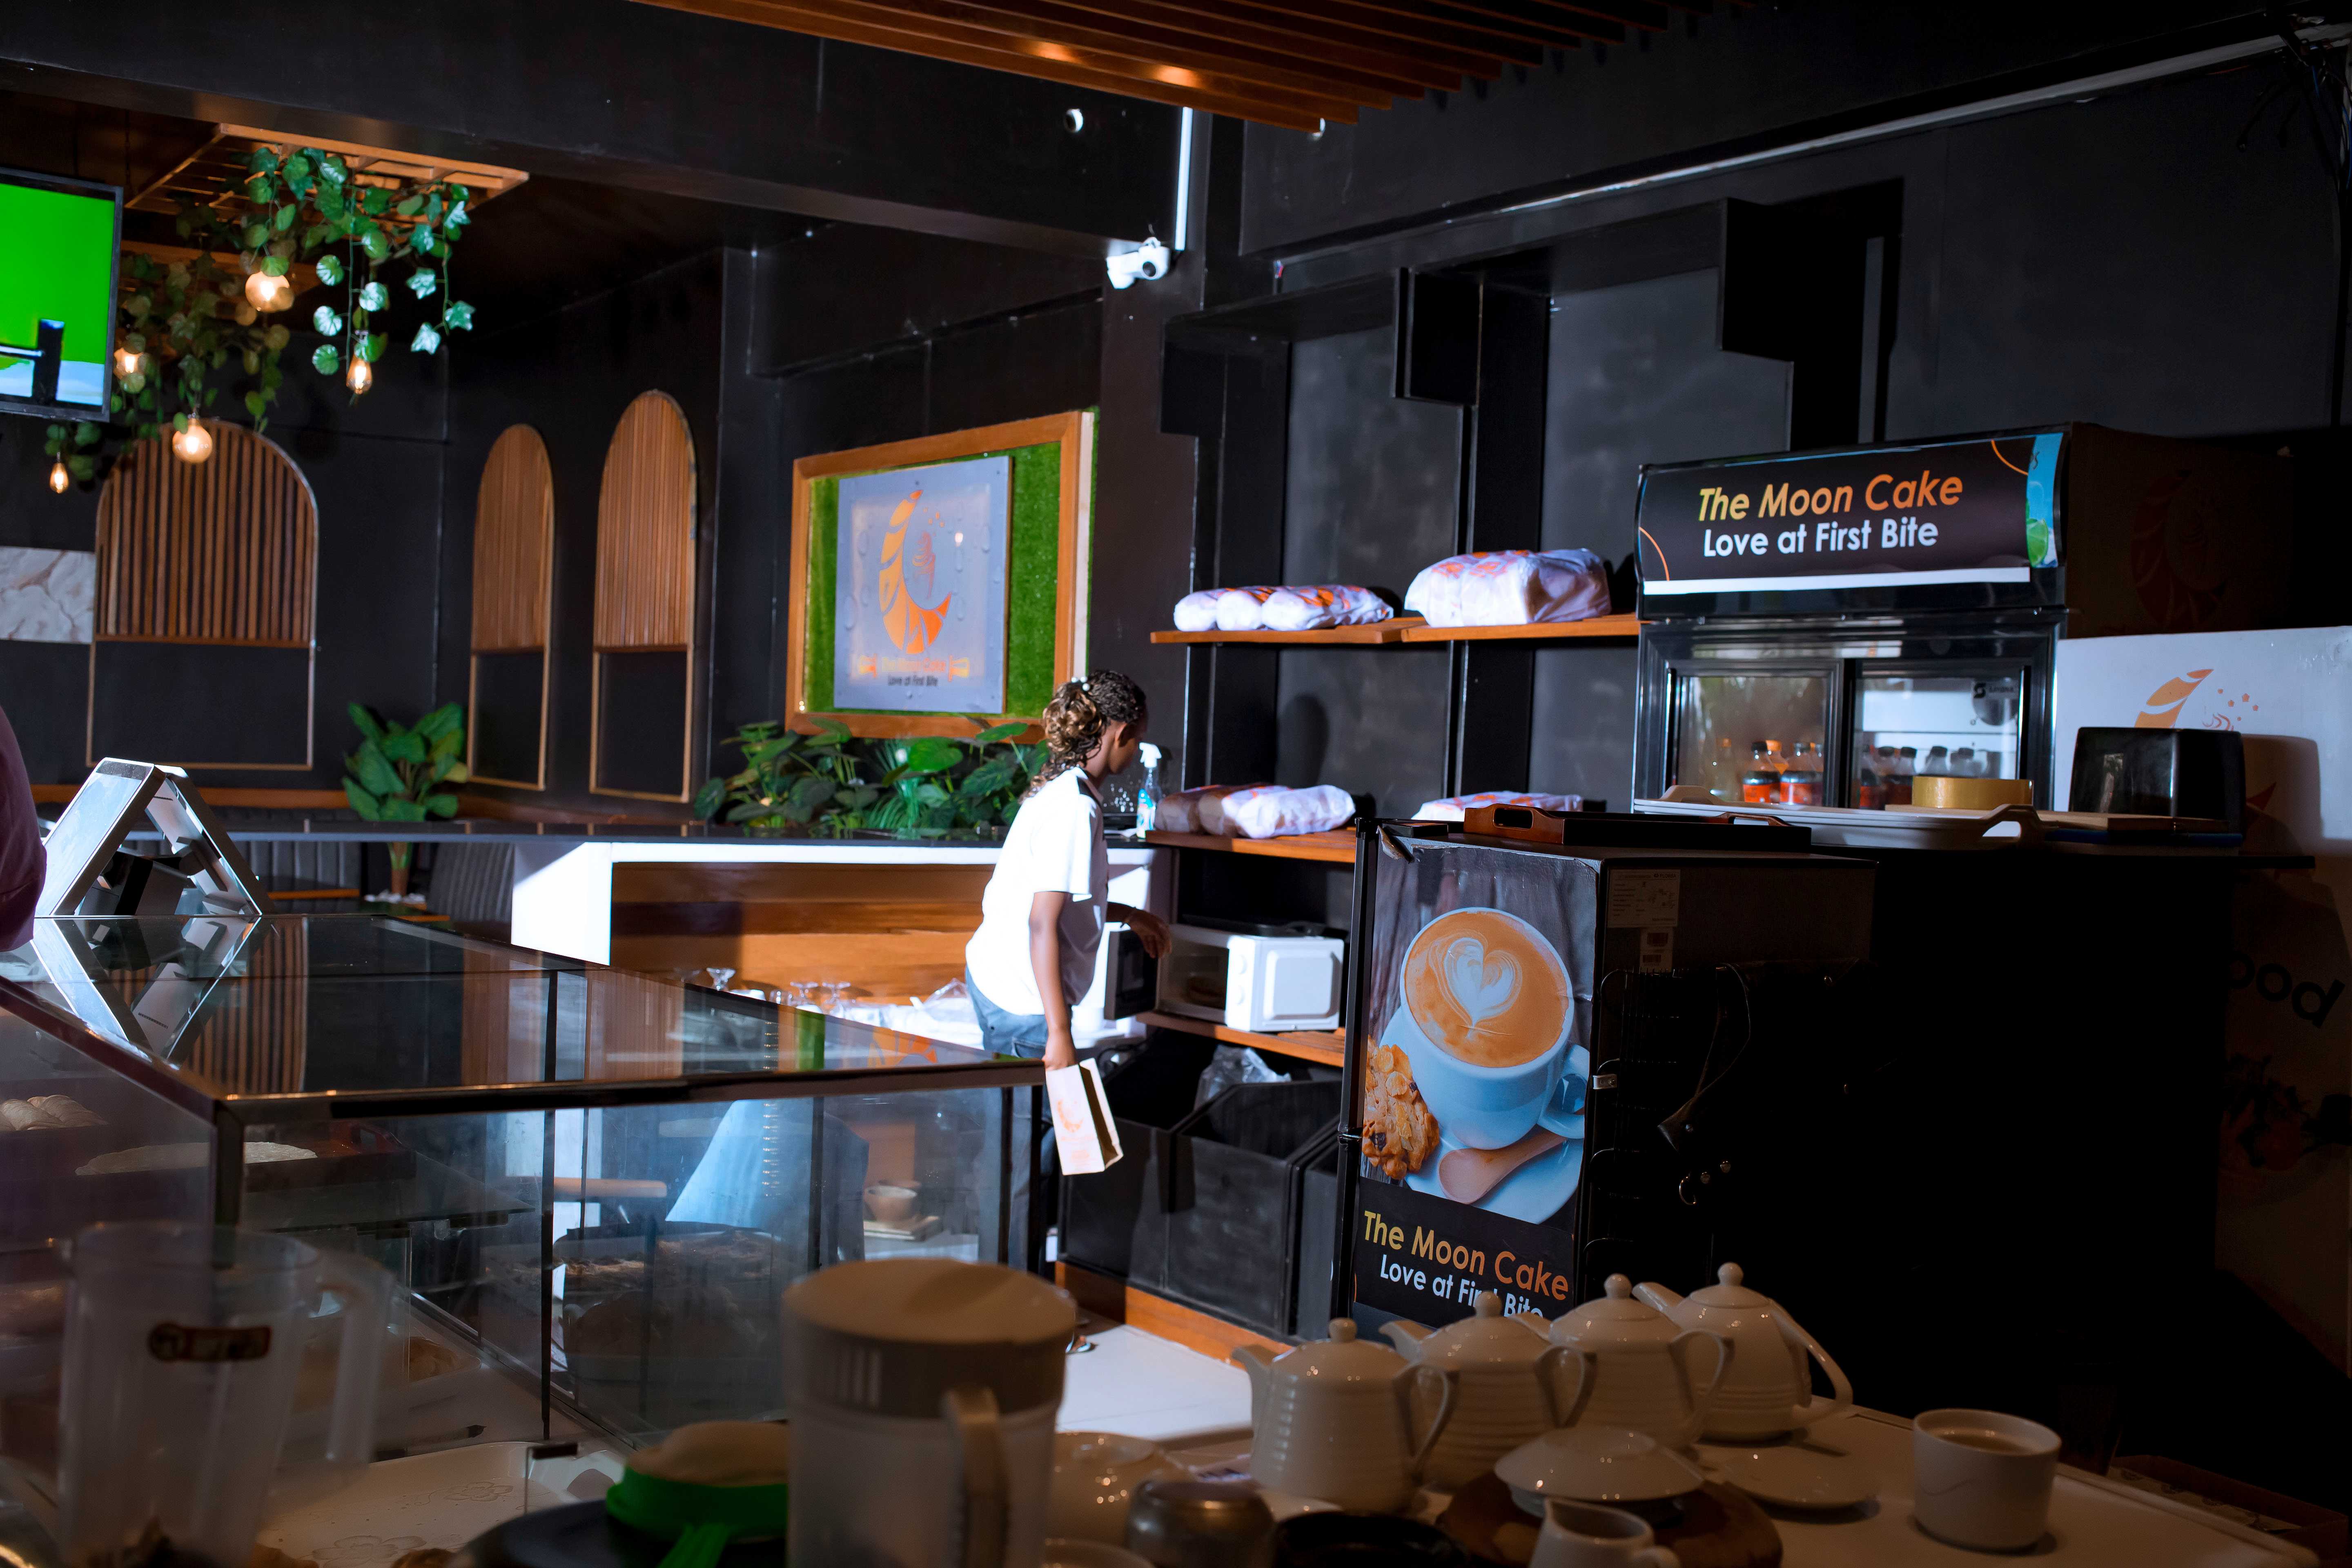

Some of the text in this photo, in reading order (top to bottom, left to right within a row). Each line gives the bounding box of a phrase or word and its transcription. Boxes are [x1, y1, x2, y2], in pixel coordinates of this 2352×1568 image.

[1699, 470, 1963, 521] The Moon Cake
[1704, 516, 1939, 557] Love at First Bite
[1364, 1210, 1569, 1301] The Moon Cake
[1380, 1254, 1427, 1291] Love
[1432, 1274, 1454, 1299] at
[1457, 1278, 1498, 1308] Fir
